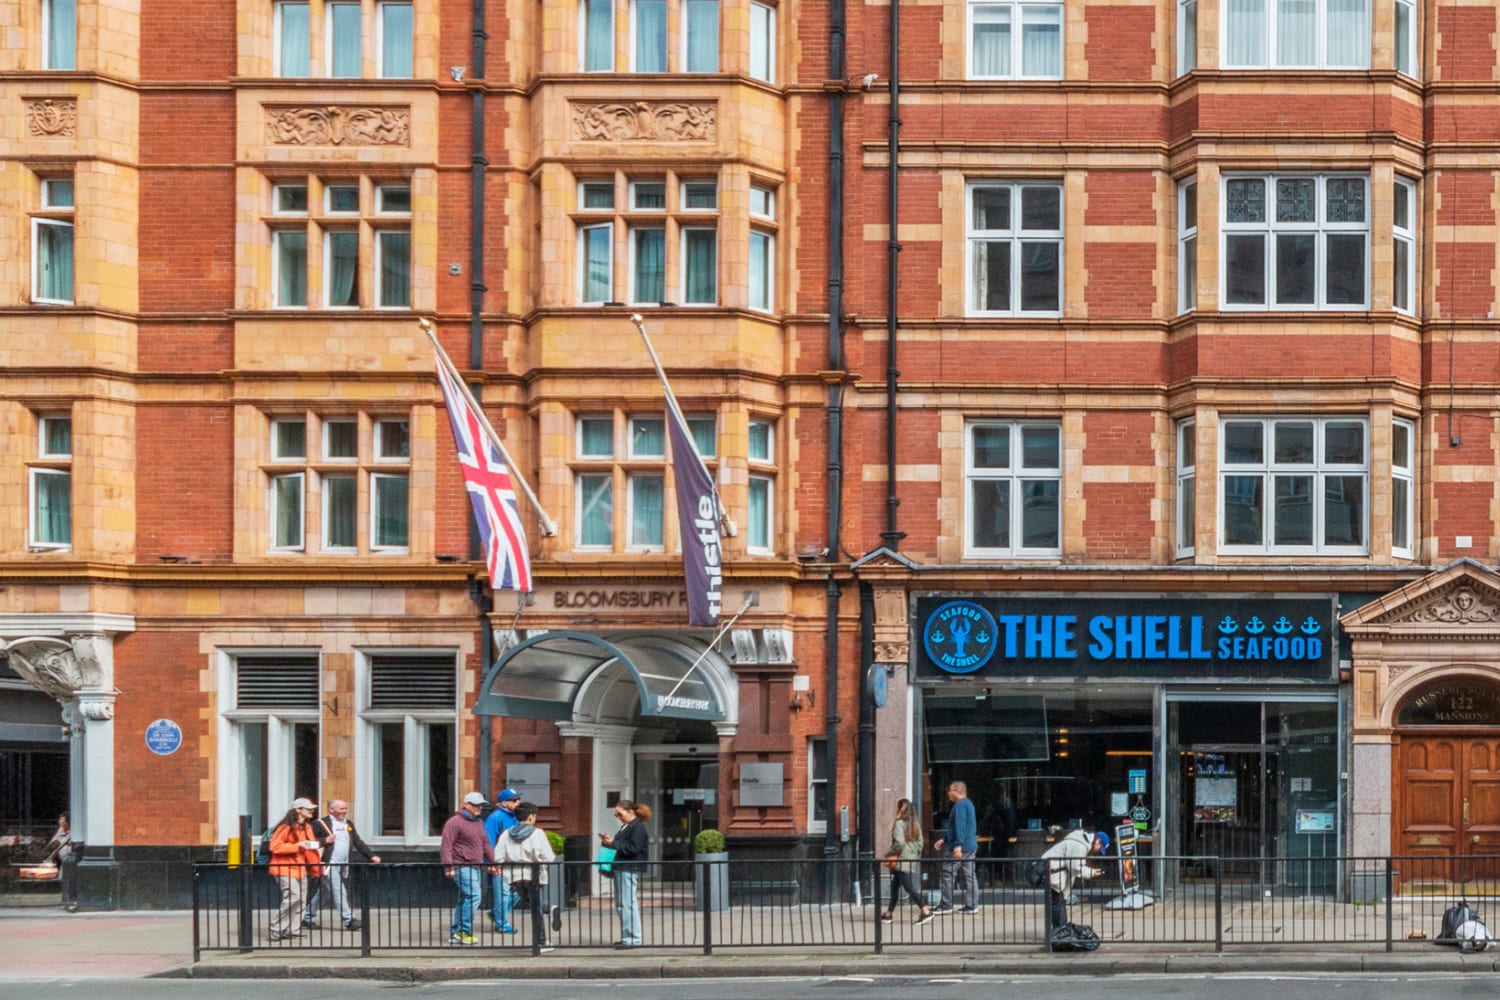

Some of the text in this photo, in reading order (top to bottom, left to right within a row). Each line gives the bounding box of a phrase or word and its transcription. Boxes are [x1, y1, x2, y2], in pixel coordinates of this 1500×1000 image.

[694, 495, 722, 618] thistle
[554, 591, 674, 608] BLOOMSBURY
[940, 606, 981, 621] SEAFOOD
[1000, 615, 1211, 659] THE SHELL
[1217, 637, 1322, 659] SEAFOOD
[941, 653, 980, 667] THE SHELL
[1450, 697, 1474, 709] 122
[1434, 711, 1489, 721] MANSIONS
